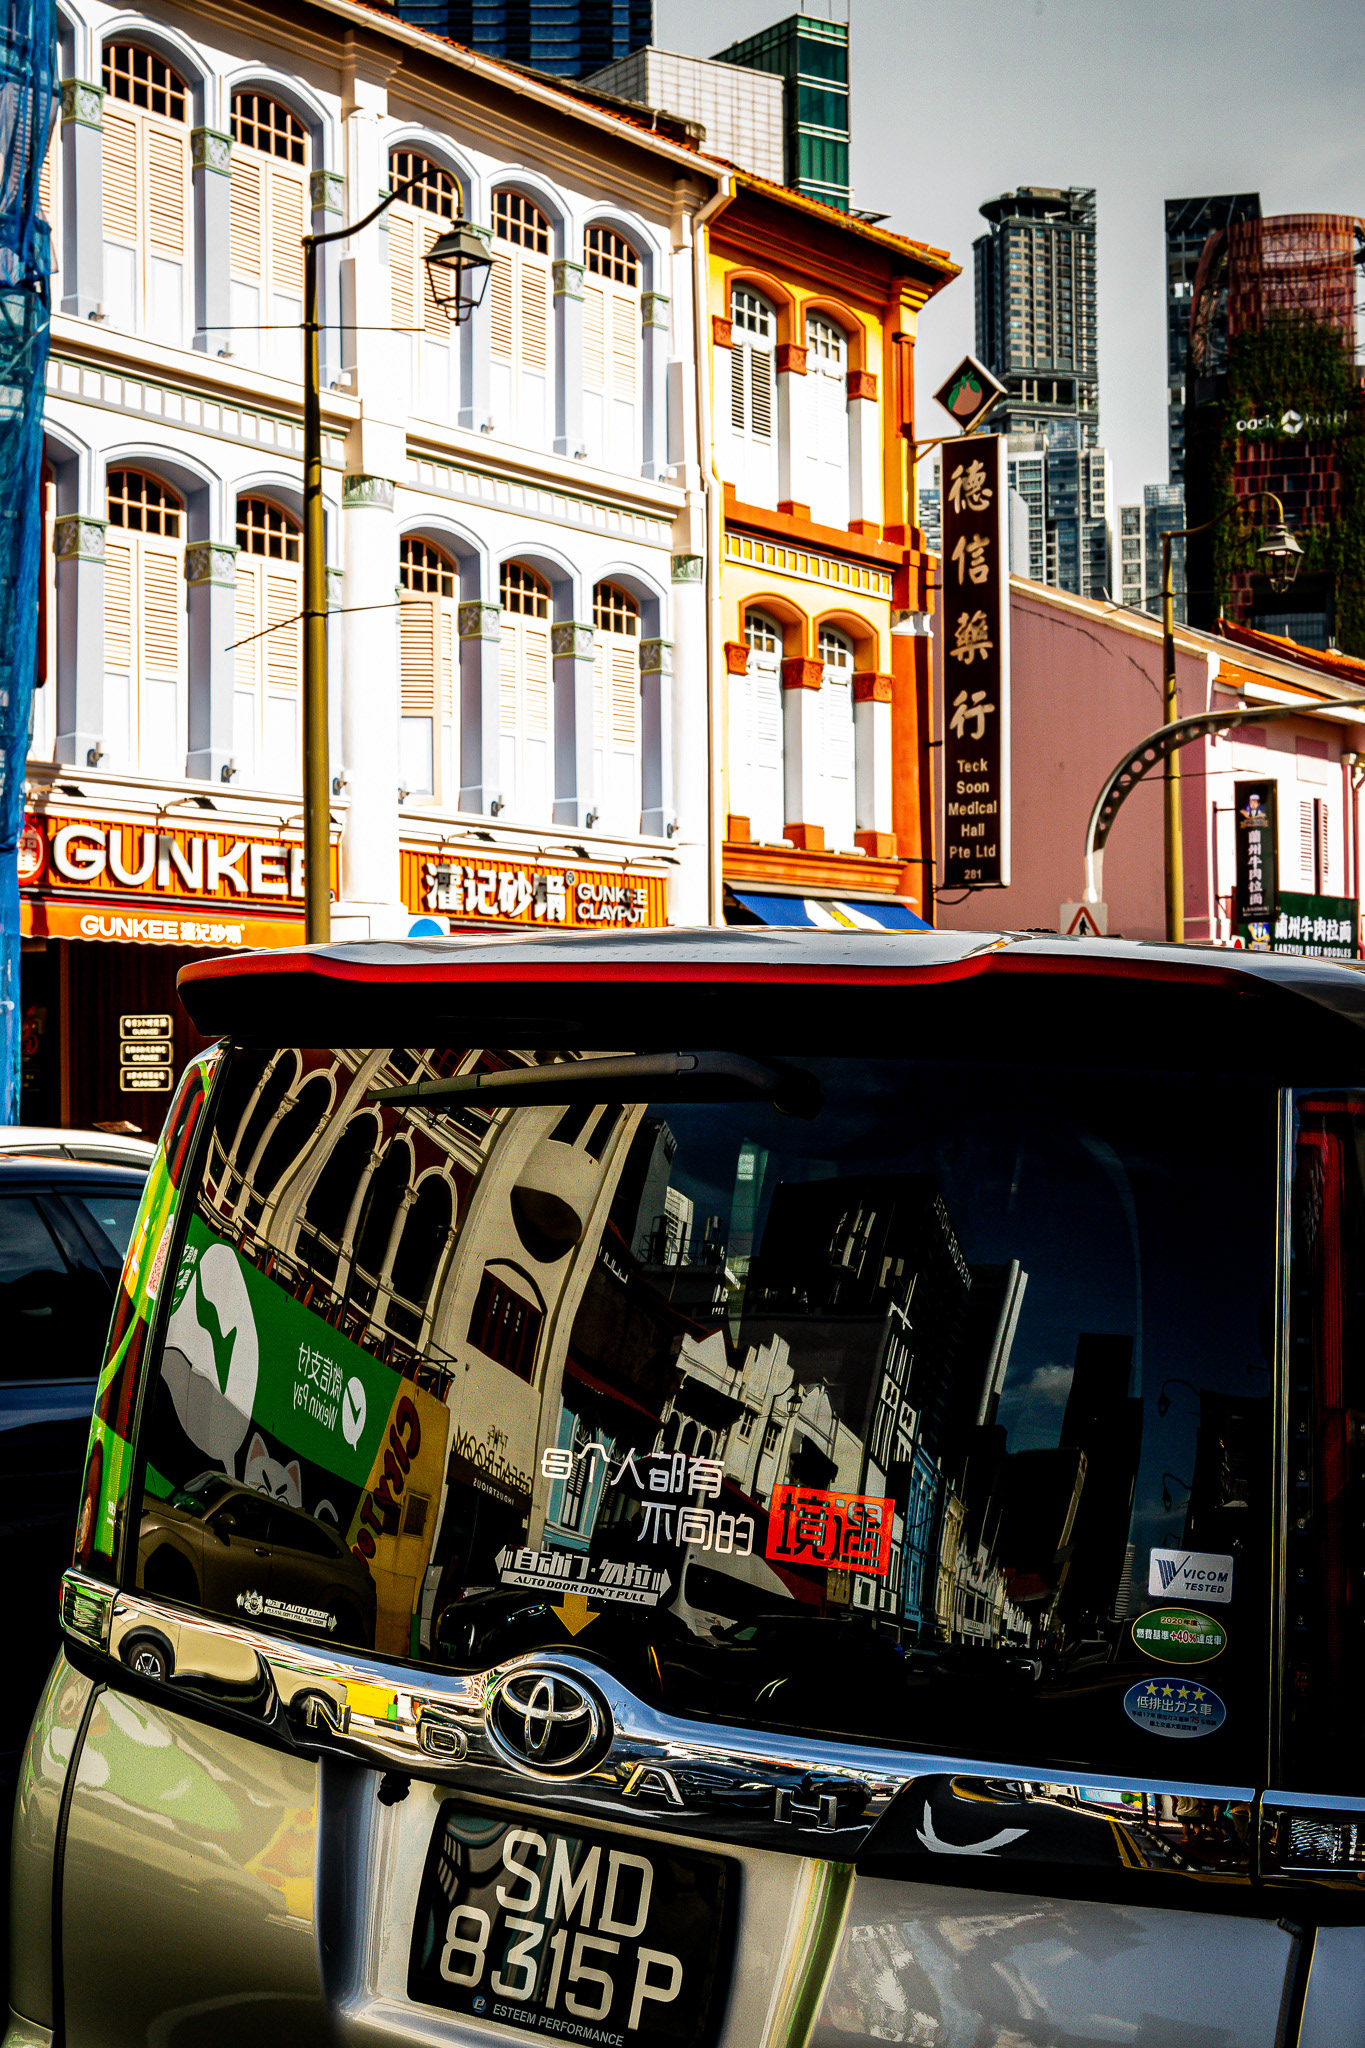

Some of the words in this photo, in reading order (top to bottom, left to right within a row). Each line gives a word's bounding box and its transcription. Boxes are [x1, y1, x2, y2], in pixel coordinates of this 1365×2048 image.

[948, 459, 995, 741] 德信藥行
[957, 758, 988, 773] Teck
[956, 779, 990, 794] Soon
[948, 800, 997, 816] Medical
[961, 822, 985, 838] Hall
[949, 844, 971, 860] Pte
[975, 843, 996, 859] Ltd
[963, 868, 982, 880] 281
[577, 883, 647, 906] GUNKEE
[577, 902, 647, 923] CLAYPOT
[80, 914, 179, 940] GUNKEE
[637, 1500, 755, 1556] 不同的
[1183, 1568, 1229, 1583] VICOM
[513, 1575, 545, 1587] AUTO
[547, 1581, 579, 1592] DOOR
[580, 1586, 615, 1597] DON'T
[615, 1591, 646, 1602] PULL
[1185, 1582, 1225, 1594] TESTED
[286, 1603, 308, 1615] AUTO
[307, 1609, 329, 1620] DOOR
[1137, 1695, 1213, 1716] 低排出ガス車
[495, 1829, 654, 1938] SMD
[440, 1904, 620, 2021] 8315
[627, 1946, 683, 2031] P
[492, 2003, 536, 2025] ESTEEM
[538, 2015, 625, 2047] PERFORMANCE
